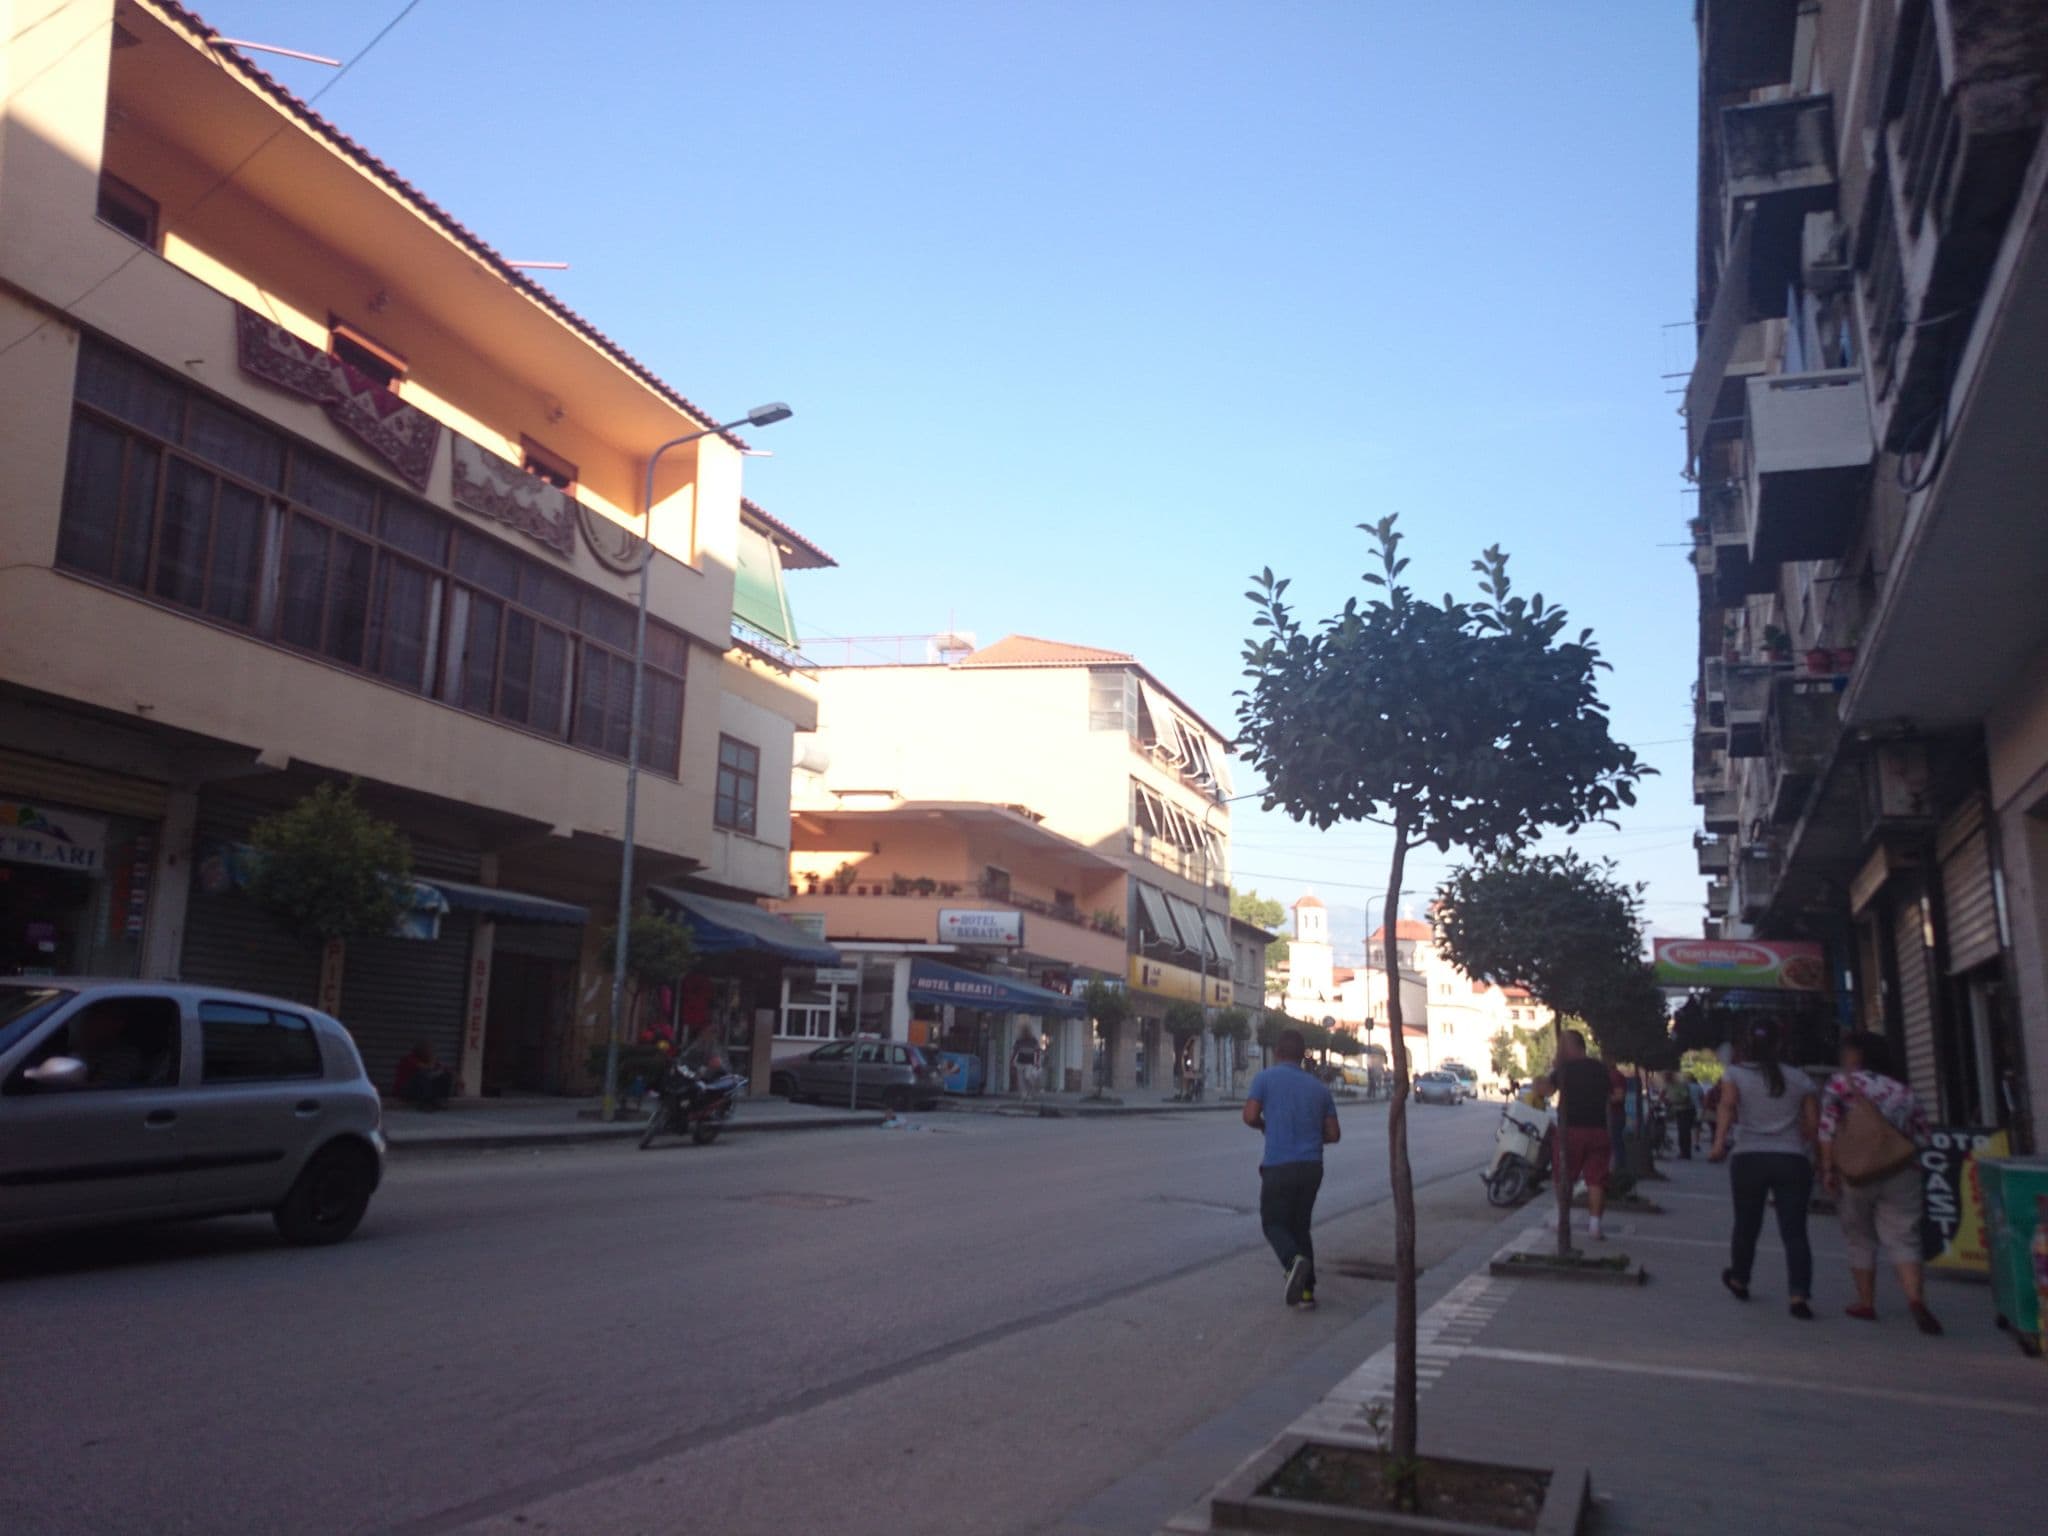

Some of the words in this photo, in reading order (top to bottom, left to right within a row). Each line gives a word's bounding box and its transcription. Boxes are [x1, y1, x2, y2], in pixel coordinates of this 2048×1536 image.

[960, 914, 997, 926] HOTEL
[917, 977, 950, 991] HOTEL
[953, 980, 993, 996] BERATI
[469, 959, 485, 1050] BYREK
